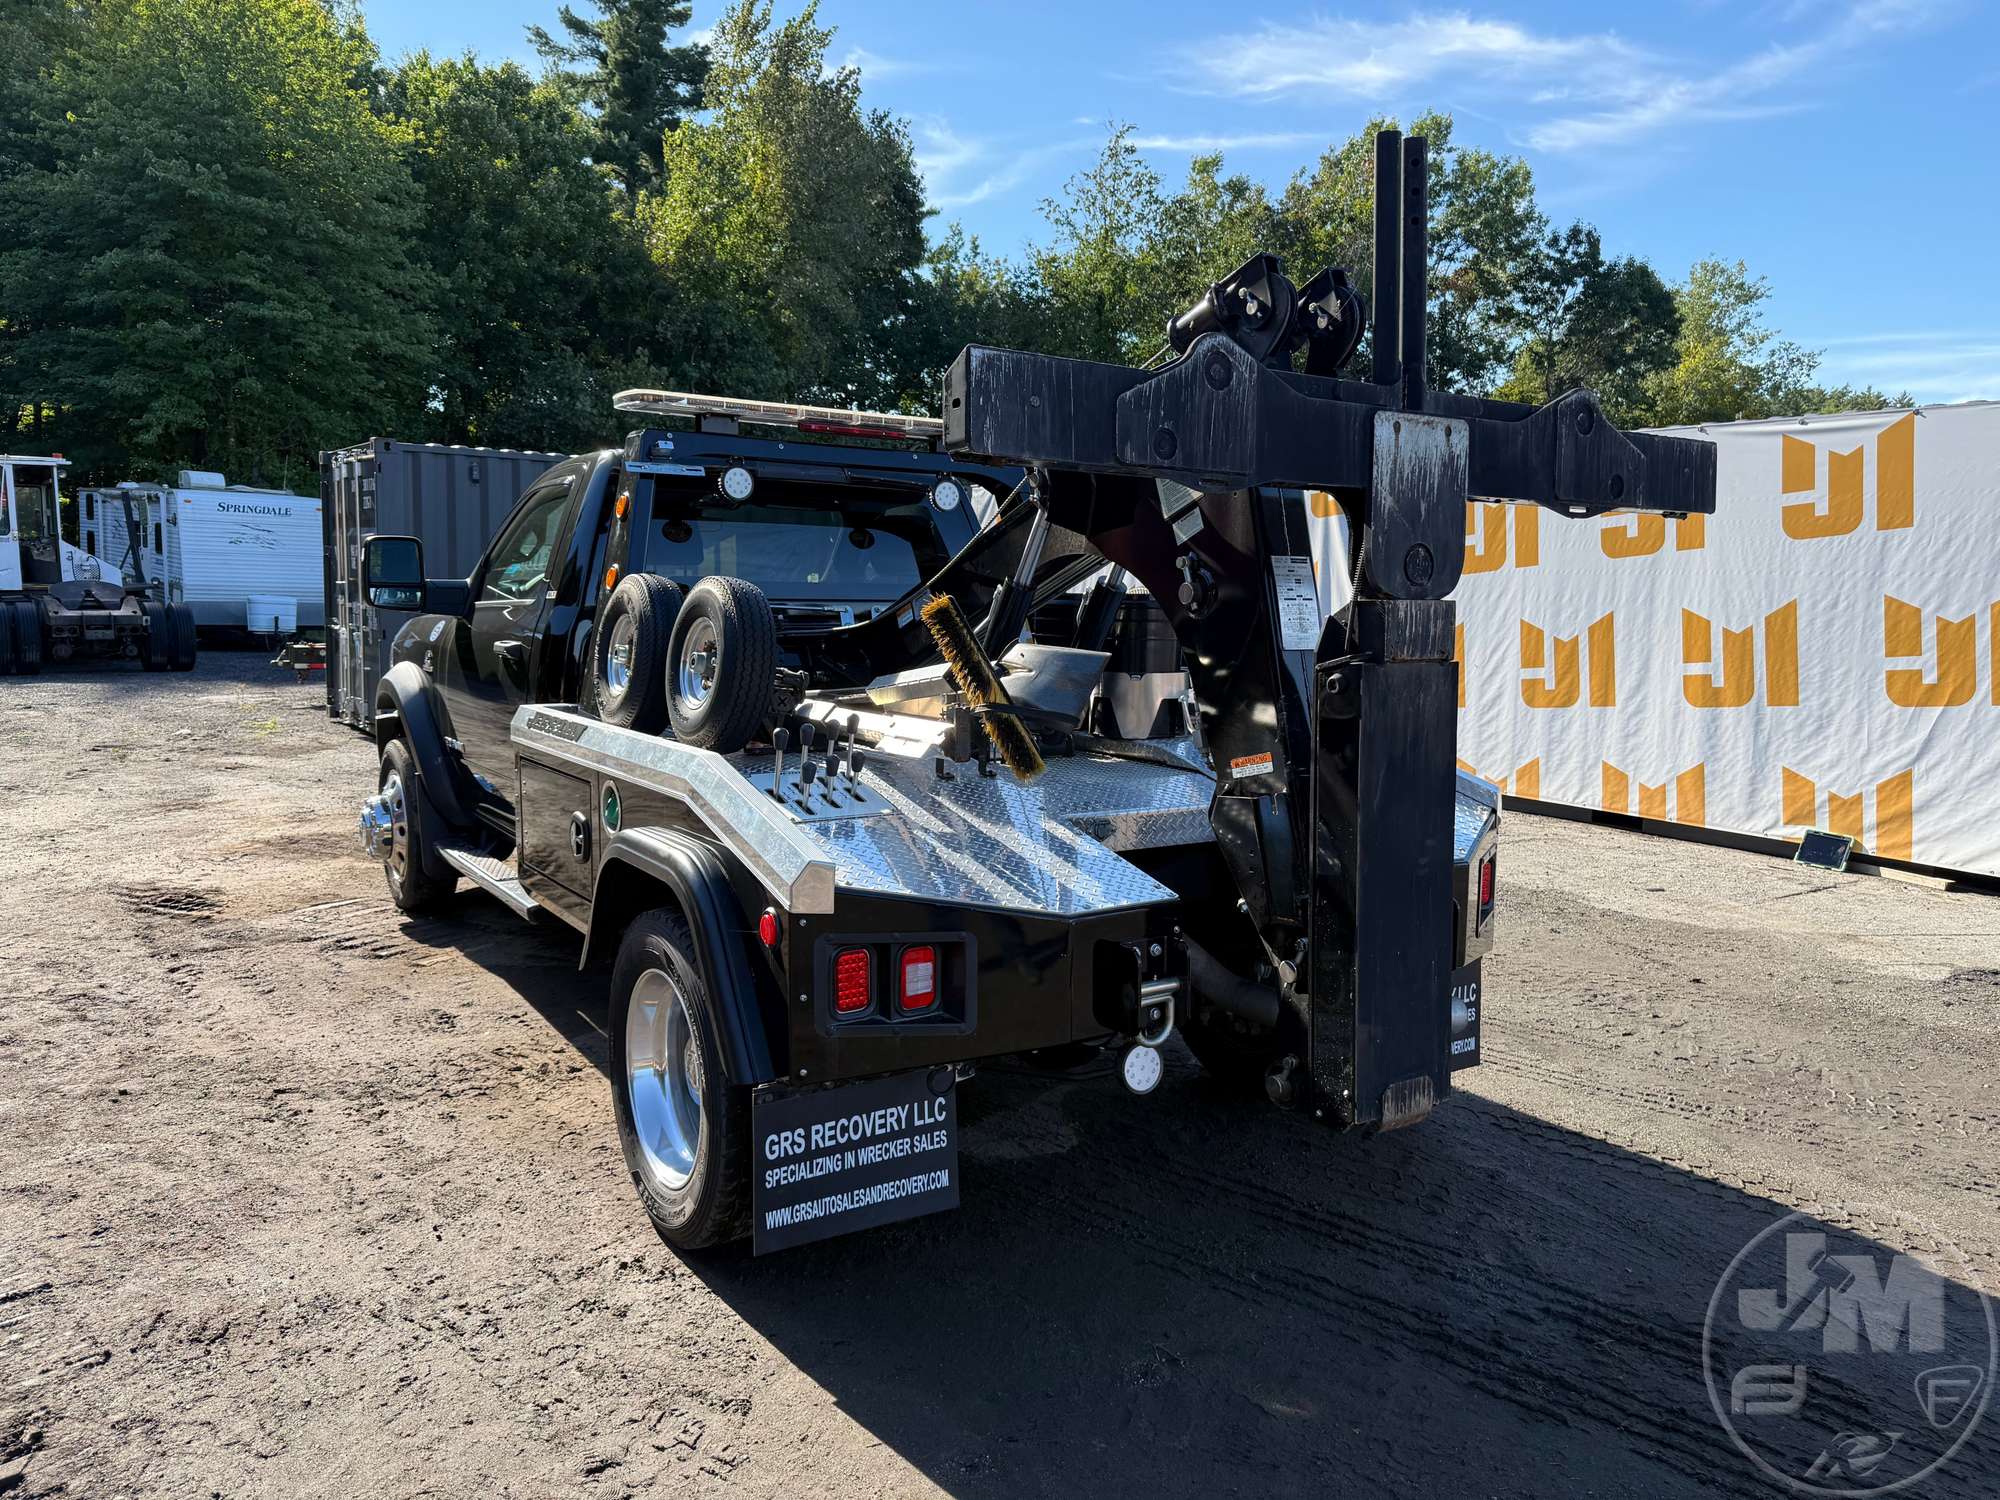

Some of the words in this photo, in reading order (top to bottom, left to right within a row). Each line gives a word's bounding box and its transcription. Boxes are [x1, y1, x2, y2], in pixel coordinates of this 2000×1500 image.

[216, 501, 292, 516] SPRINGDALE
[765, 1128, 806, 1161] GRS
[811, 1104, 909, 1150] RECOVERY
[914, 1096, 947, 1127] LLC
[765, 1154, 842, 1189] SPECIALIZING
[844, 1149, 856, 1170] IN
[857, 1137, 912, 1166] WRECKER
[913, 1130, 948, 1153] SALES
[765, 1168, 950, 1231] WWW.GRSAUTOSALESANDRECOVERY.COM
